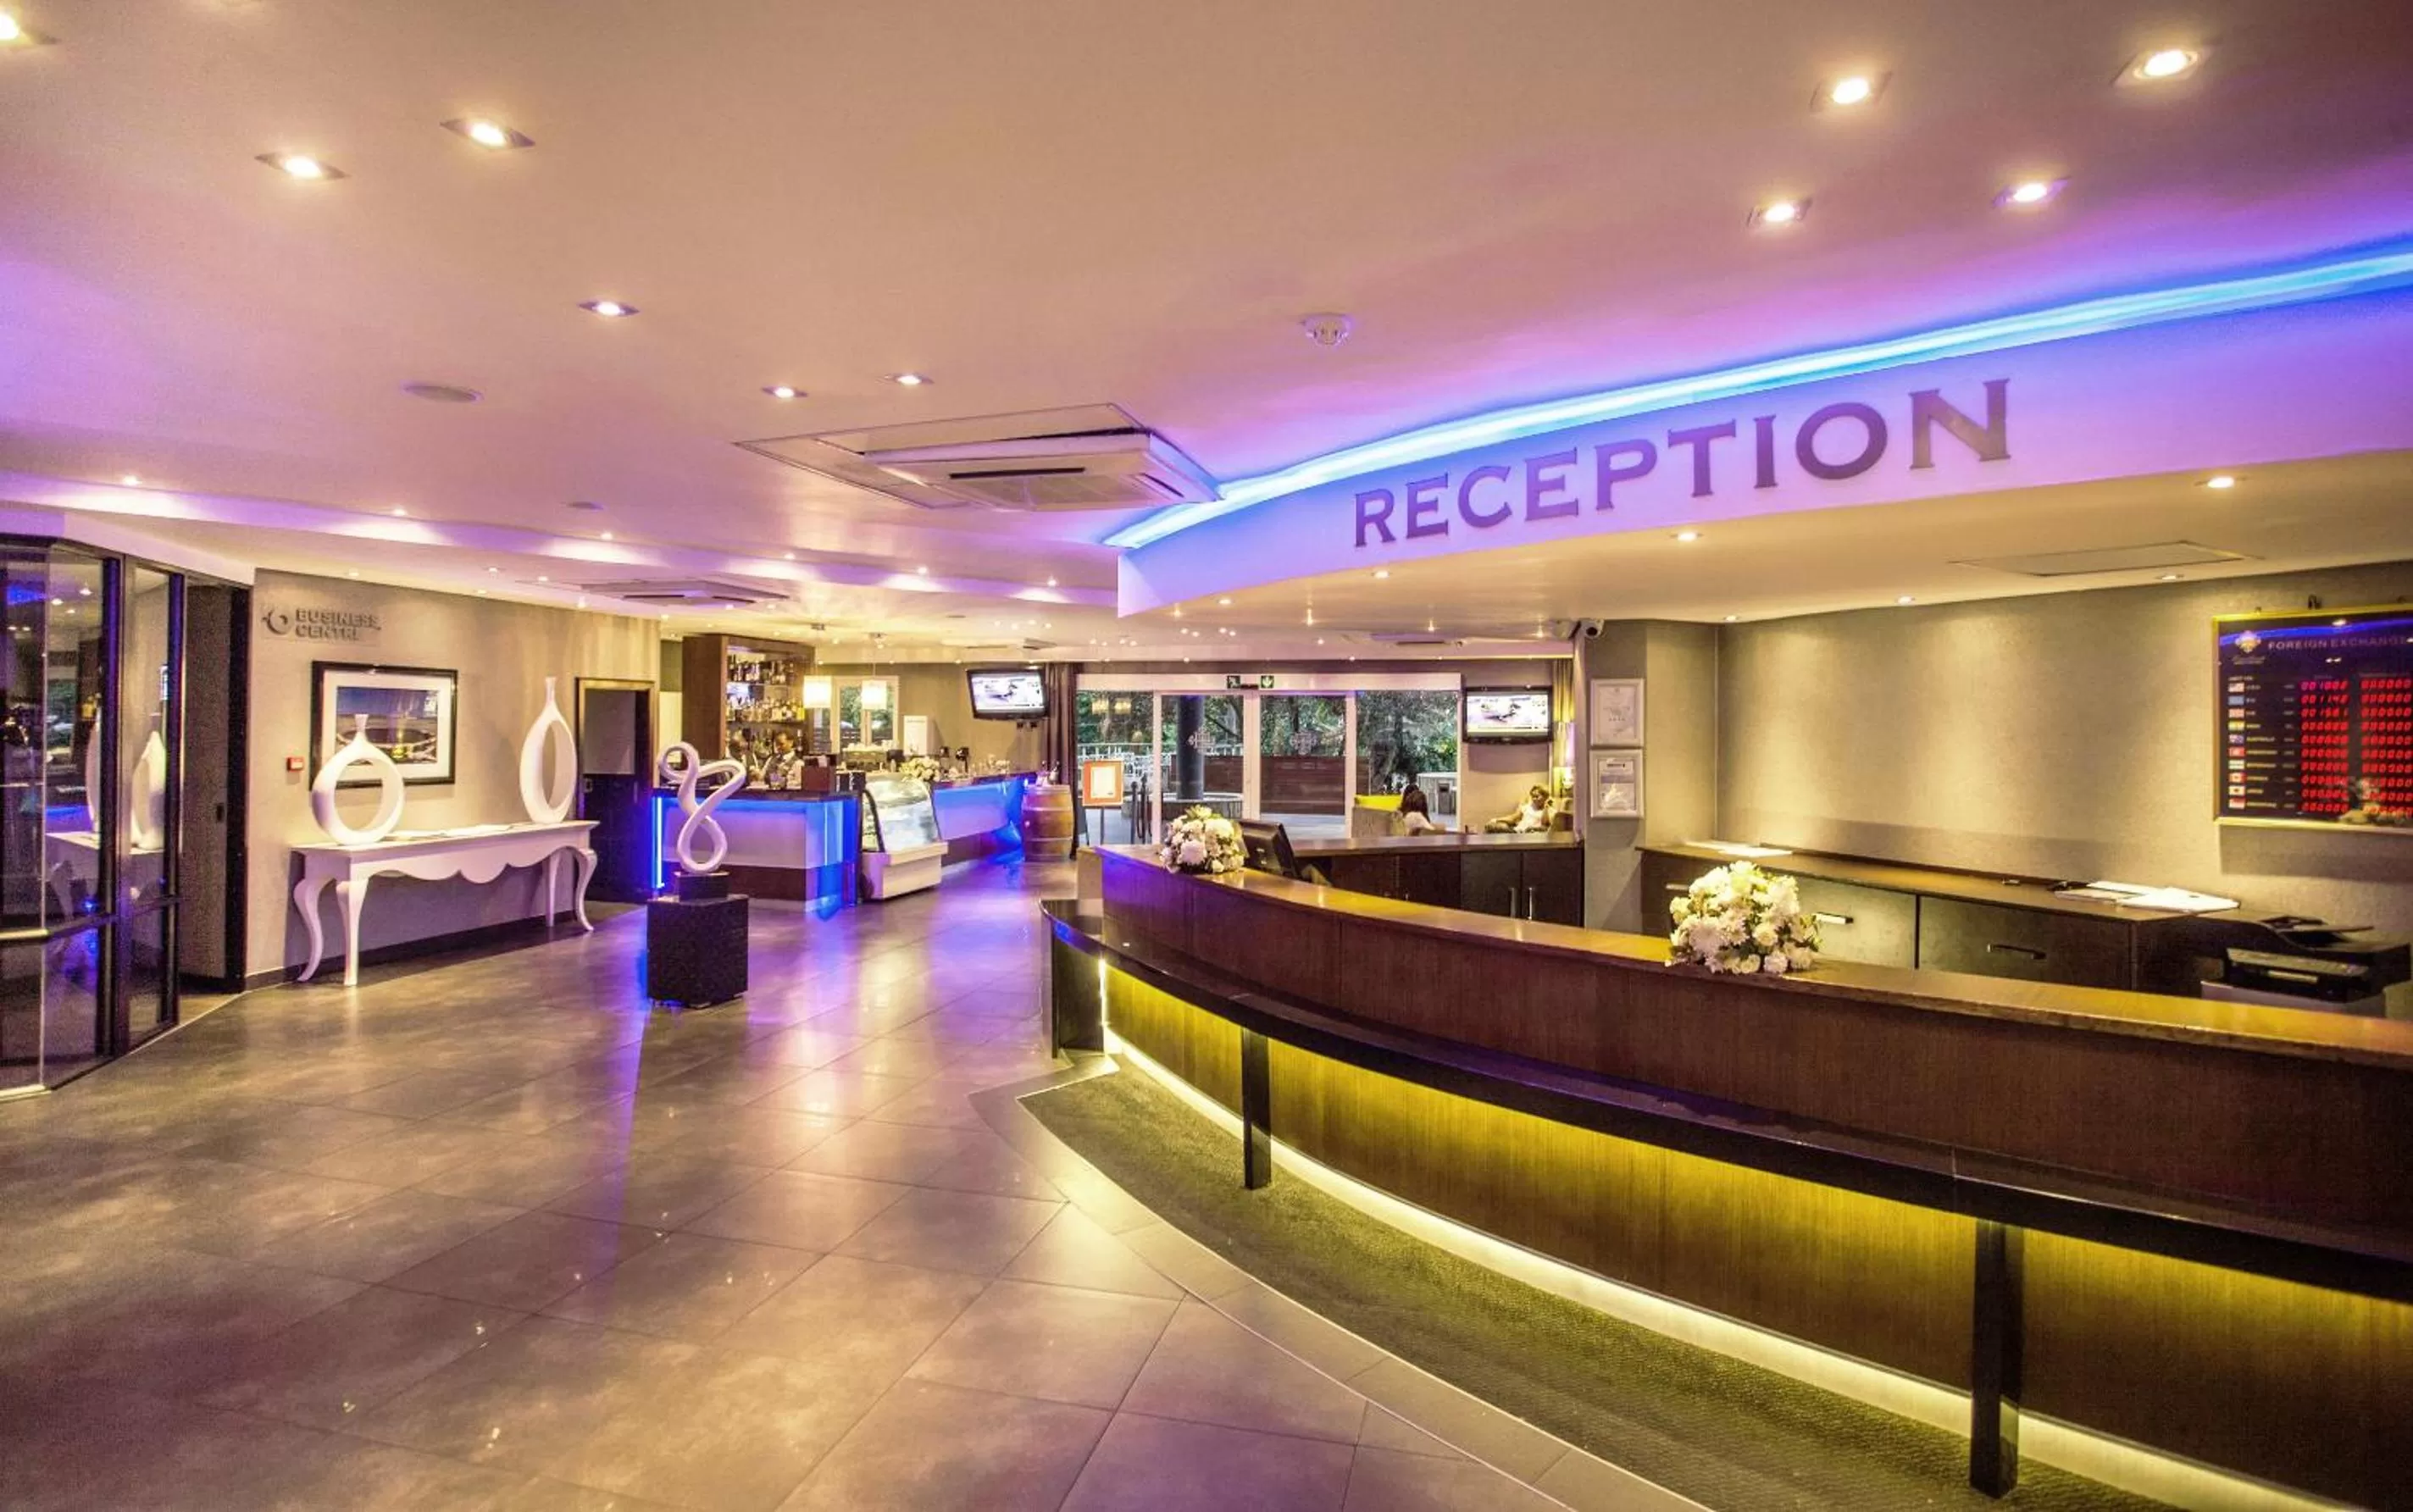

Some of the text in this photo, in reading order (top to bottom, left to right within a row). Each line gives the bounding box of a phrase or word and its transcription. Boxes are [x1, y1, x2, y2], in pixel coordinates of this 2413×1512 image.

[1355, 378, 2011, 548] RECEPTION
[295, 608, 382, 630] BUSINESS
[2268, 640, 2327, 650] FOREIGN
